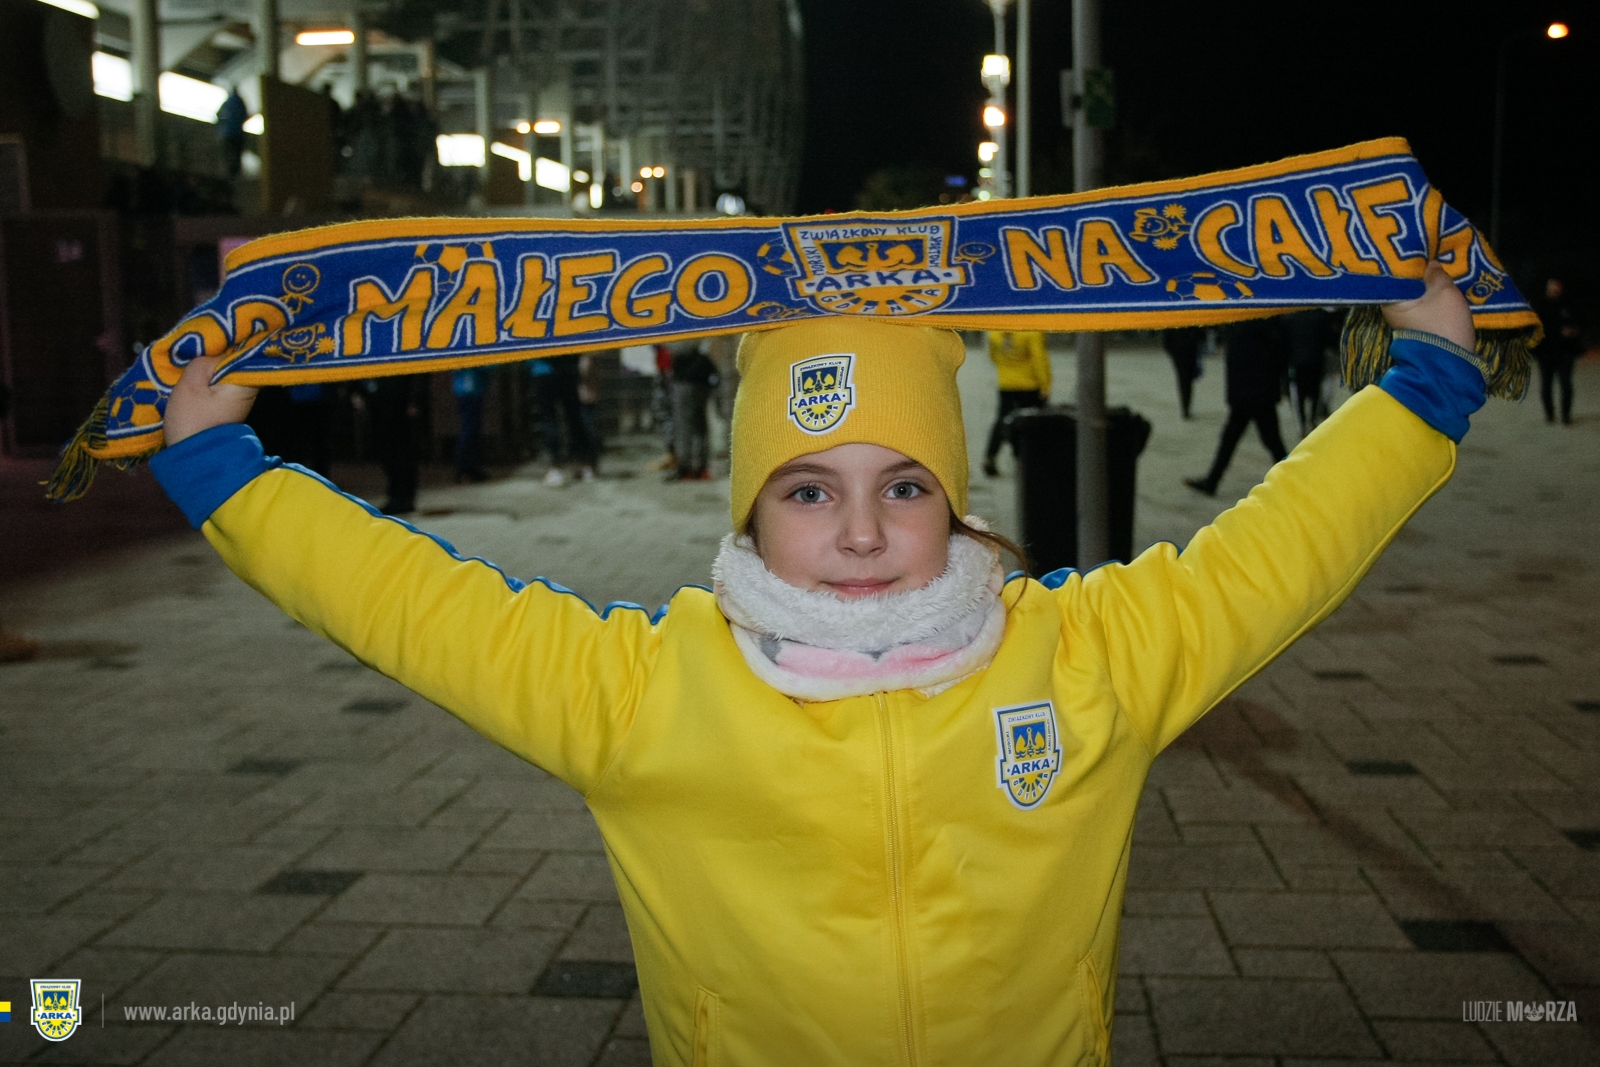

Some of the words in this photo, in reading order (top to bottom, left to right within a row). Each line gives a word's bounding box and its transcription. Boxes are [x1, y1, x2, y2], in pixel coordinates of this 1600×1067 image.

[896, 225, 940, 235] KLUB
[335, 250, 757, 358] MAŁEGO
[999, 217, 1160, 291] NA
[1190, 173, 1506, 287] CAŁEG
[816, 270, 941, 292] ARKA
[797, 393, 841, 408] ARKA
[1011, 759, 1050, 775] ARKA
